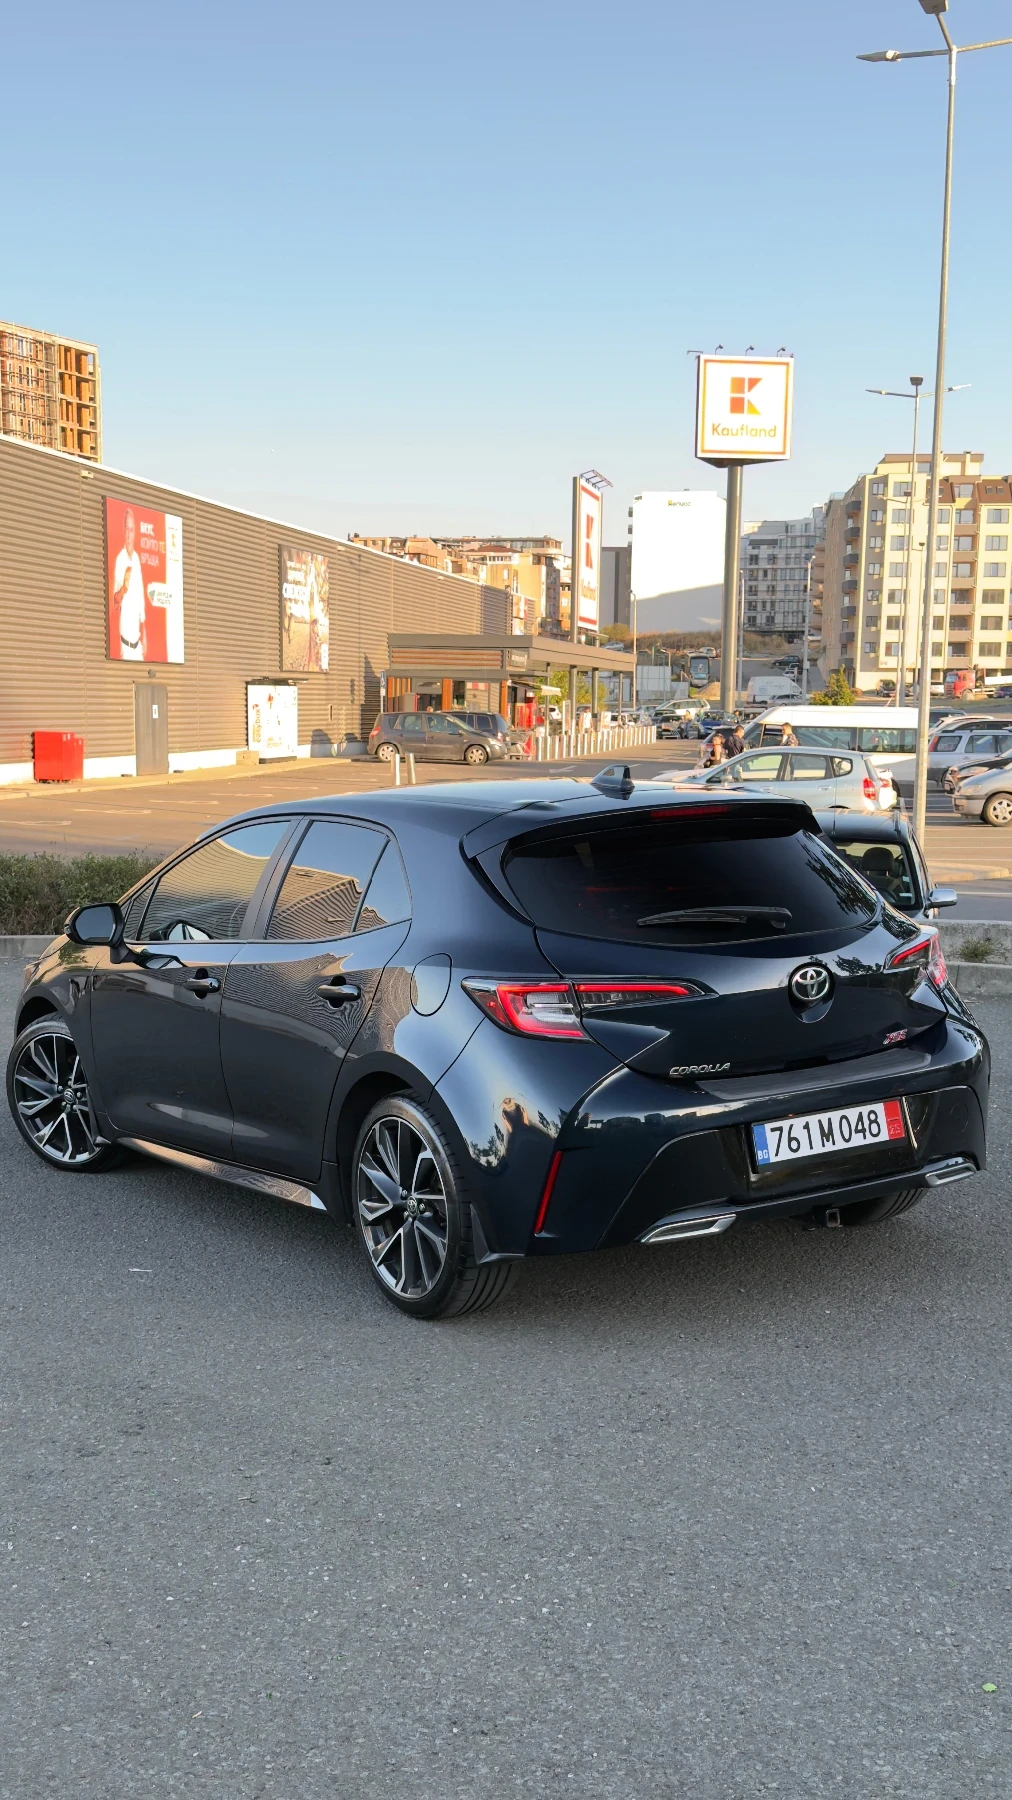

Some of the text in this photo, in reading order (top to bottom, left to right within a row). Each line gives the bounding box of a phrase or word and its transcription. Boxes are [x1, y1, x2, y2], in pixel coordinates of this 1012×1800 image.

[711, 422, 777, 438] Kaufland
[669, 1062, 731, 1075] COROLLA
[757, 1149, 769, 1160] BG
